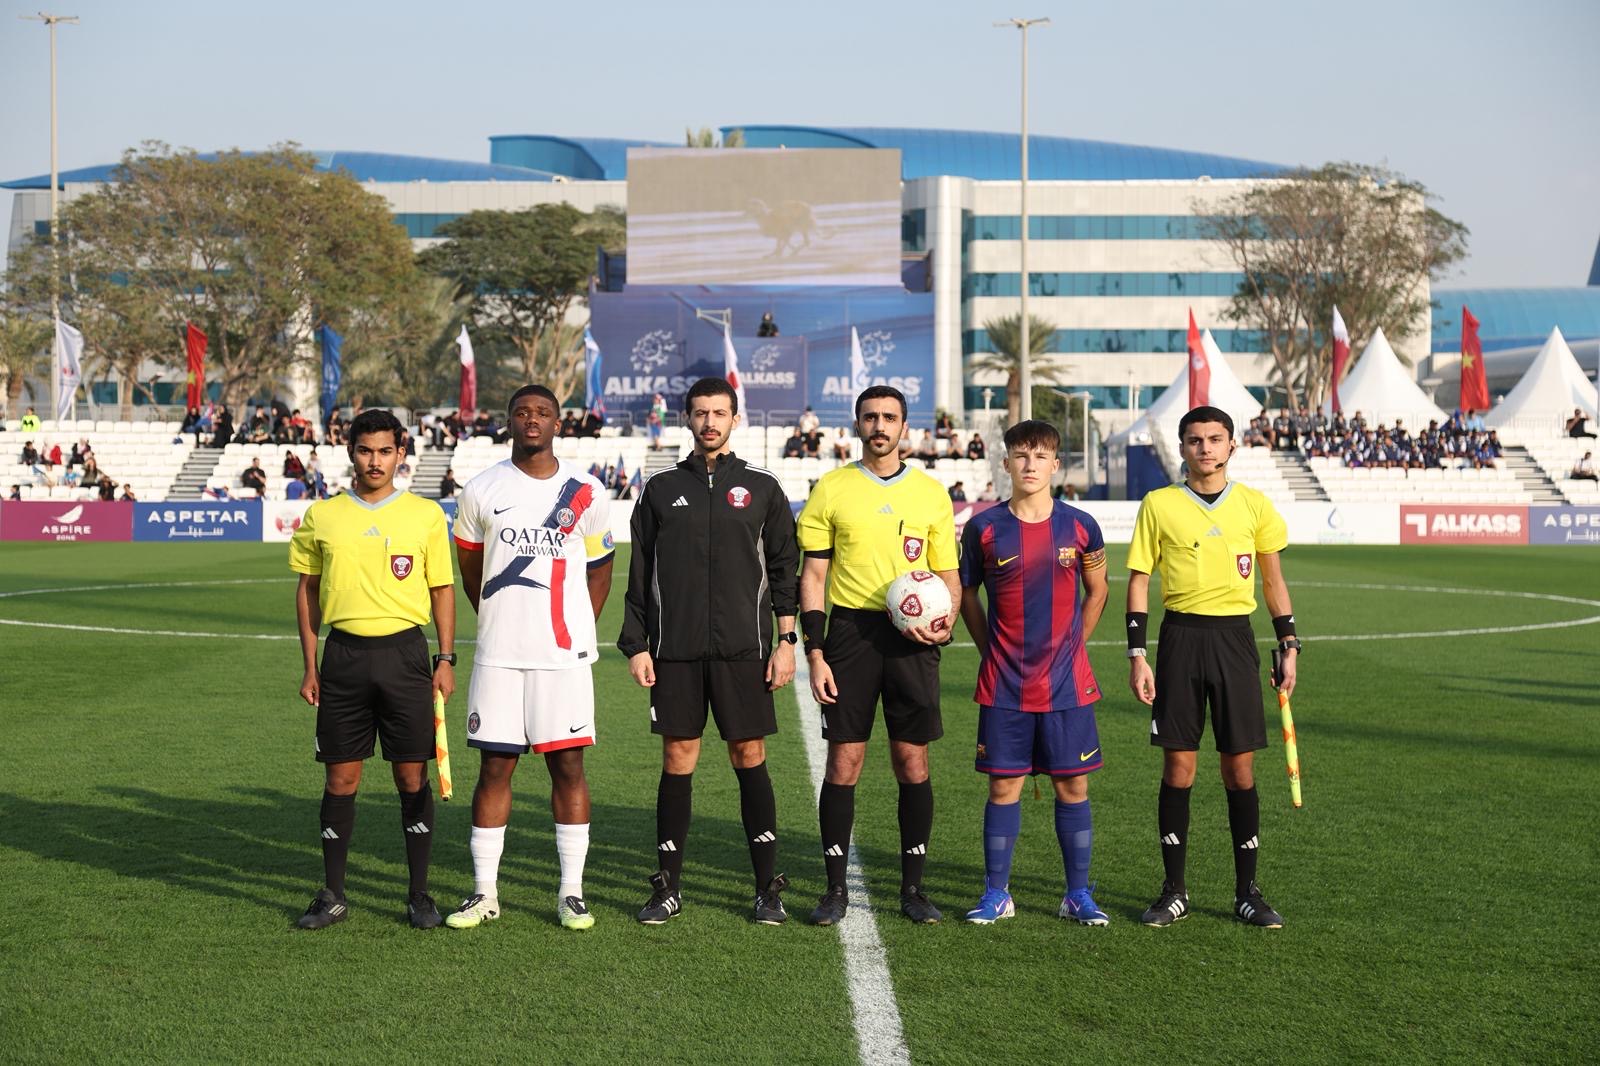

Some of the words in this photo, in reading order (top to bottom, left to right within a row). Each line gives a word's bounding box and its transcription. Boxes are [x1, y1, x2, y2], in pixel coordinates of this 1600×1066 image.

[822, 376, 921, 396] ALASS
[147, 510, 248, 526] ASPETAR
[1431, 513, 1521, 533] ALKASS
[41, 524, 92, 535] ASPIRE
[500, 527, 565, 548] QATAR
